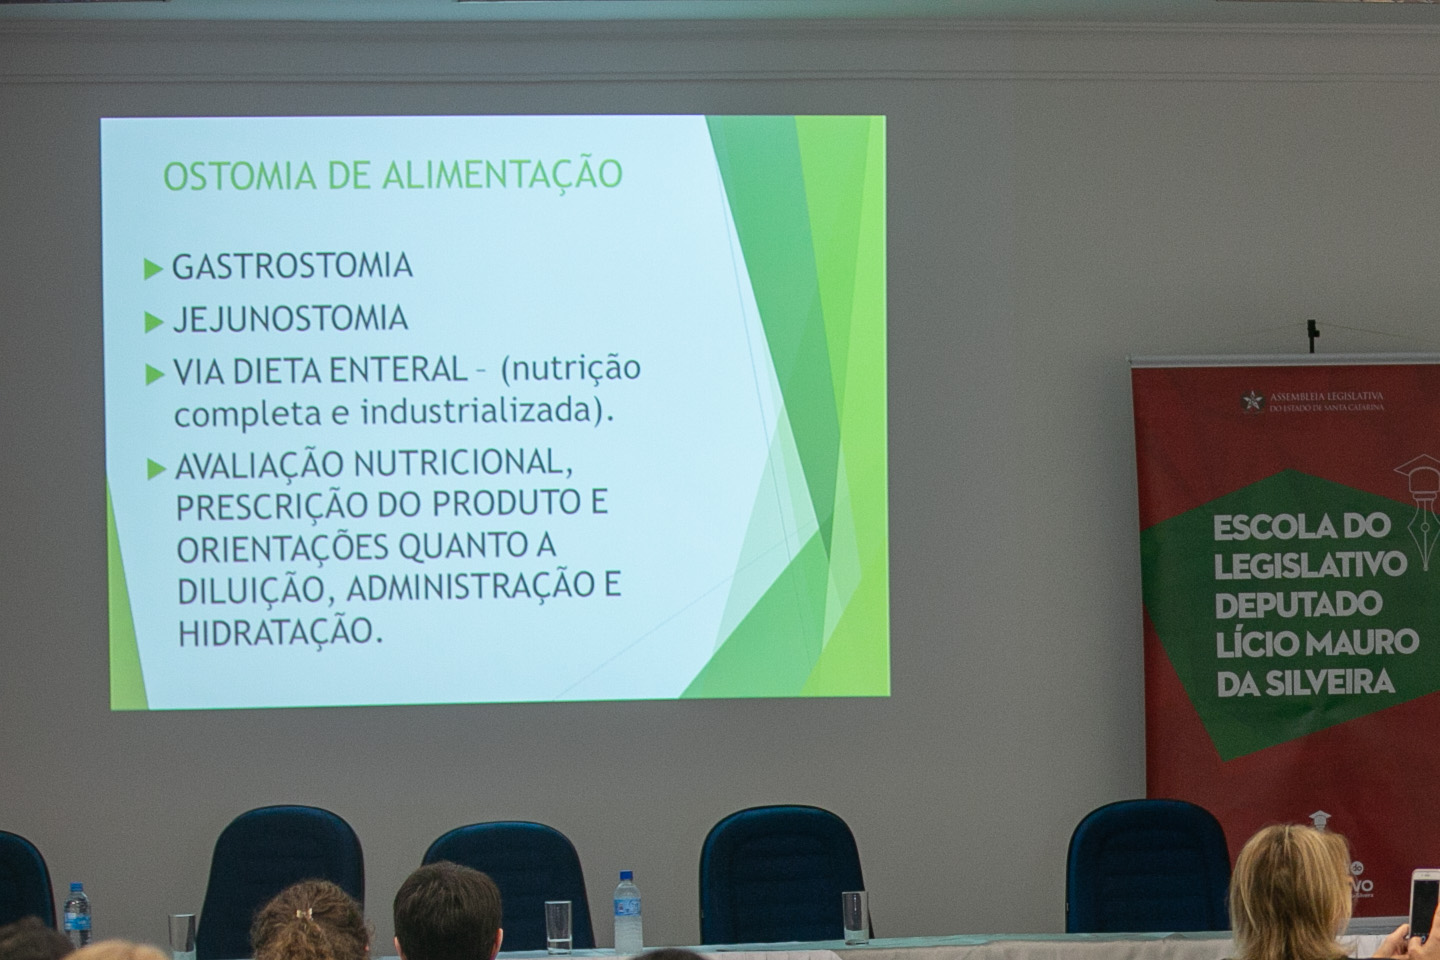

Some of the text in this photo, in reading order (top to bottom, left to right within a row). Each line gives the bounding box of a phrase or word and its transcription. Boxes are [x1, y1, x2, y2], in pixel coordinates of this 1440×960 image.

[163, 153, 623, 197] OSTOMIA DE ALIMENTAÇÃO
[172, 251, 414, 281] GASTROSTOMIA
[173, 304, 409, 334] JEJUNOSTOMIA
[173, 358, 225, 386] VIA
[234, 357, 322, 385] DIETA
[330, 354, 469, 383] ENTERAL
[501, 352, 641, 388] (nutrição
[1327, 391, 1384, 401] LEGISLATIVA
[174, 395, 615, 434] completa e industrializada).
[174, 445, 573, 486] AVALIAÇÃO NUTRICIONAL,
[177, 486, 608, 527] PRESCRIÇÃO DO PRODUTO E
[1213, 511, 1392, 541] ESCOLA DO
[177, 528, 557, 568] ORIENTAÇÕES QUANTO A
[1214, 550, 1408, 580] LEGISLATIVO
[178, 566, 622, 611] DILUIÇÃO, ADMINISTRAÇÃO E
[1215, 590, 1384, 620] DEPUTADO
[179, 612, 383, 652] HIDRATAÇÃO.
[1216, 623, 1420, 659] LÍCIO MAURO
[1217, 667, 1396, 698] DA SILVEIRA
